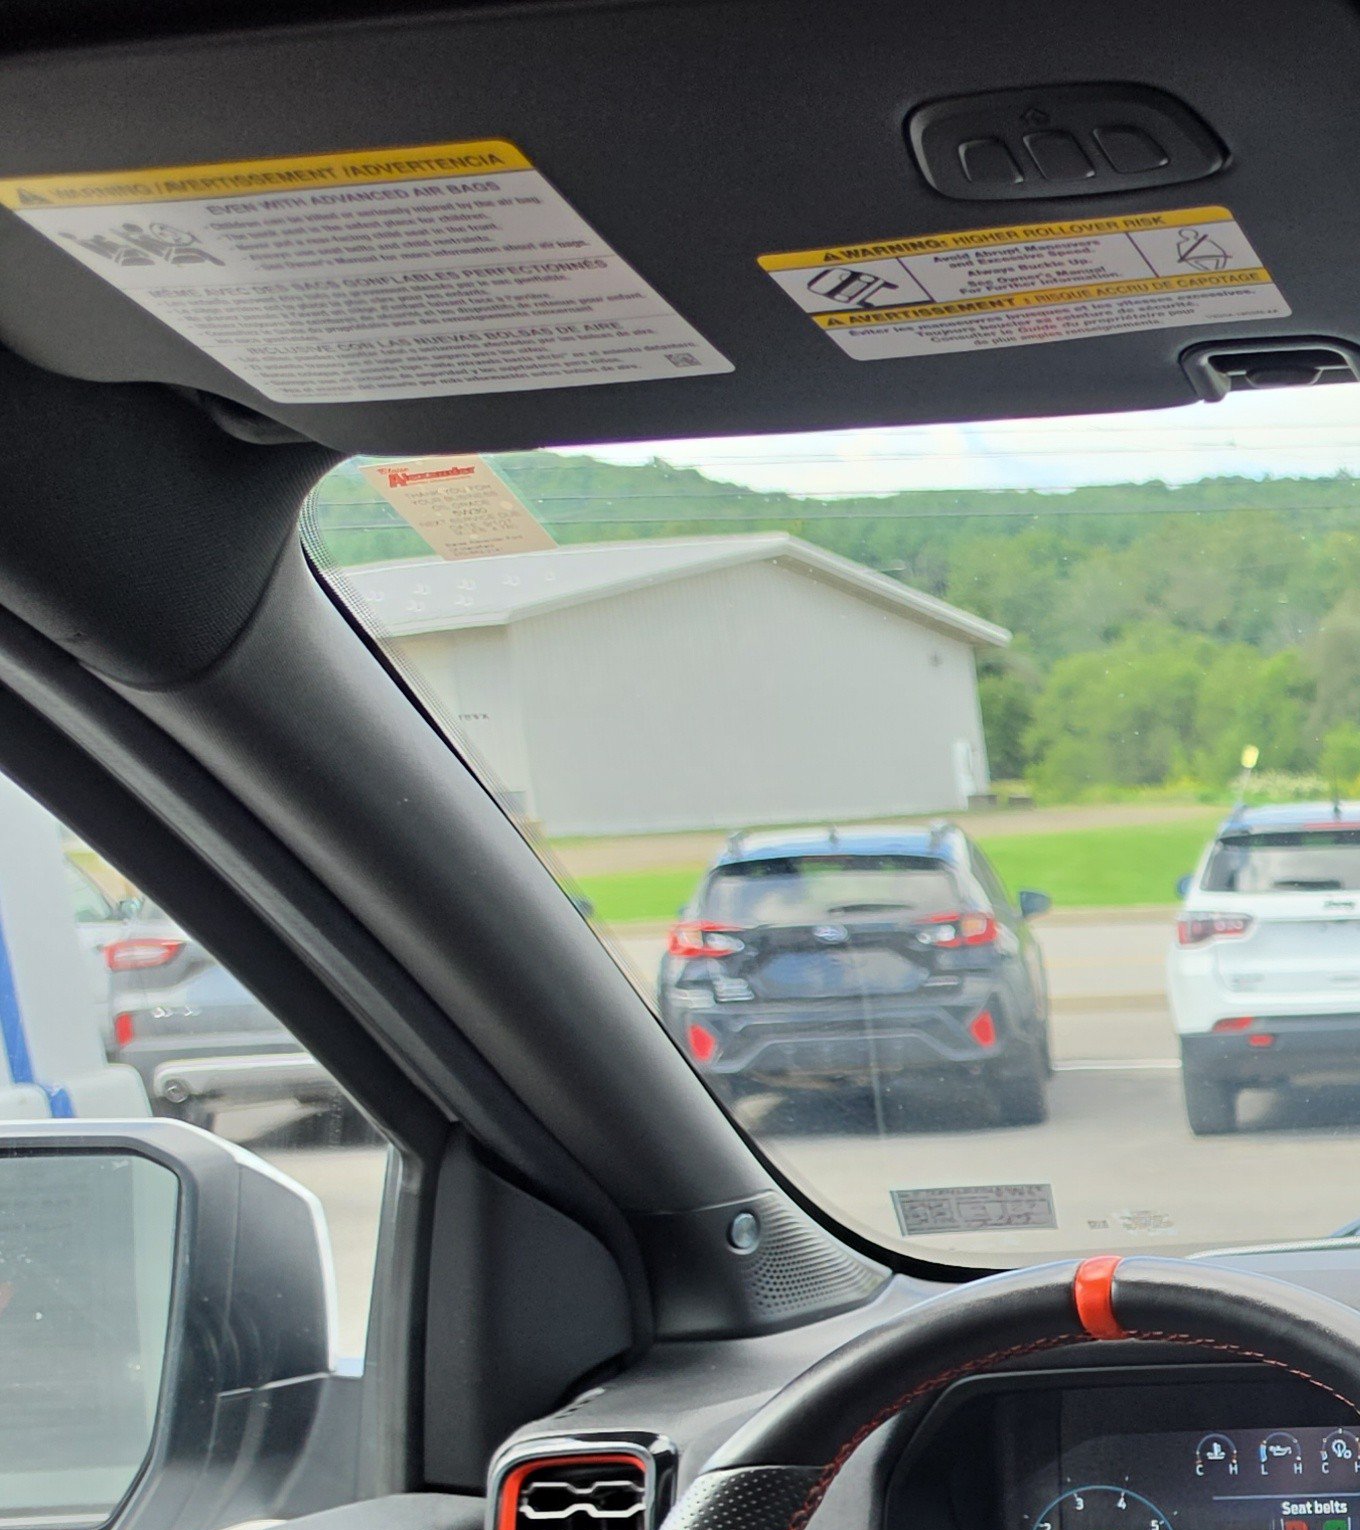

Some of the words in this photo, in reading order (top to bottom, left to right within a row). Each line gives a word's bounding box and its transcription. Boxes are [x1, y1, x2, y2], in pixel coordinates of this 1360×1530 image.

[310, 189, 410, 206] ADVANCED
[413, 184, 445, 198] AIR
[449, 181, 501, 195] BAGS
[952, 230, 1019, 246] HIGHER
[1022, 221, 1119, 238] ROLLOVER
[1124, 215, 1166, 228] RISK
[849, 298, 1017, 323] AVERTISSEMENT
[1152, 280, 1173, 291] DE
[1177, 271, 1261, 287] CAPOTAGE
[1075, 1499, 1084, 1511] 3
[1281, 1501, 1312, 1516] Seat
[1314, 1500, 1348, 1515] belts
